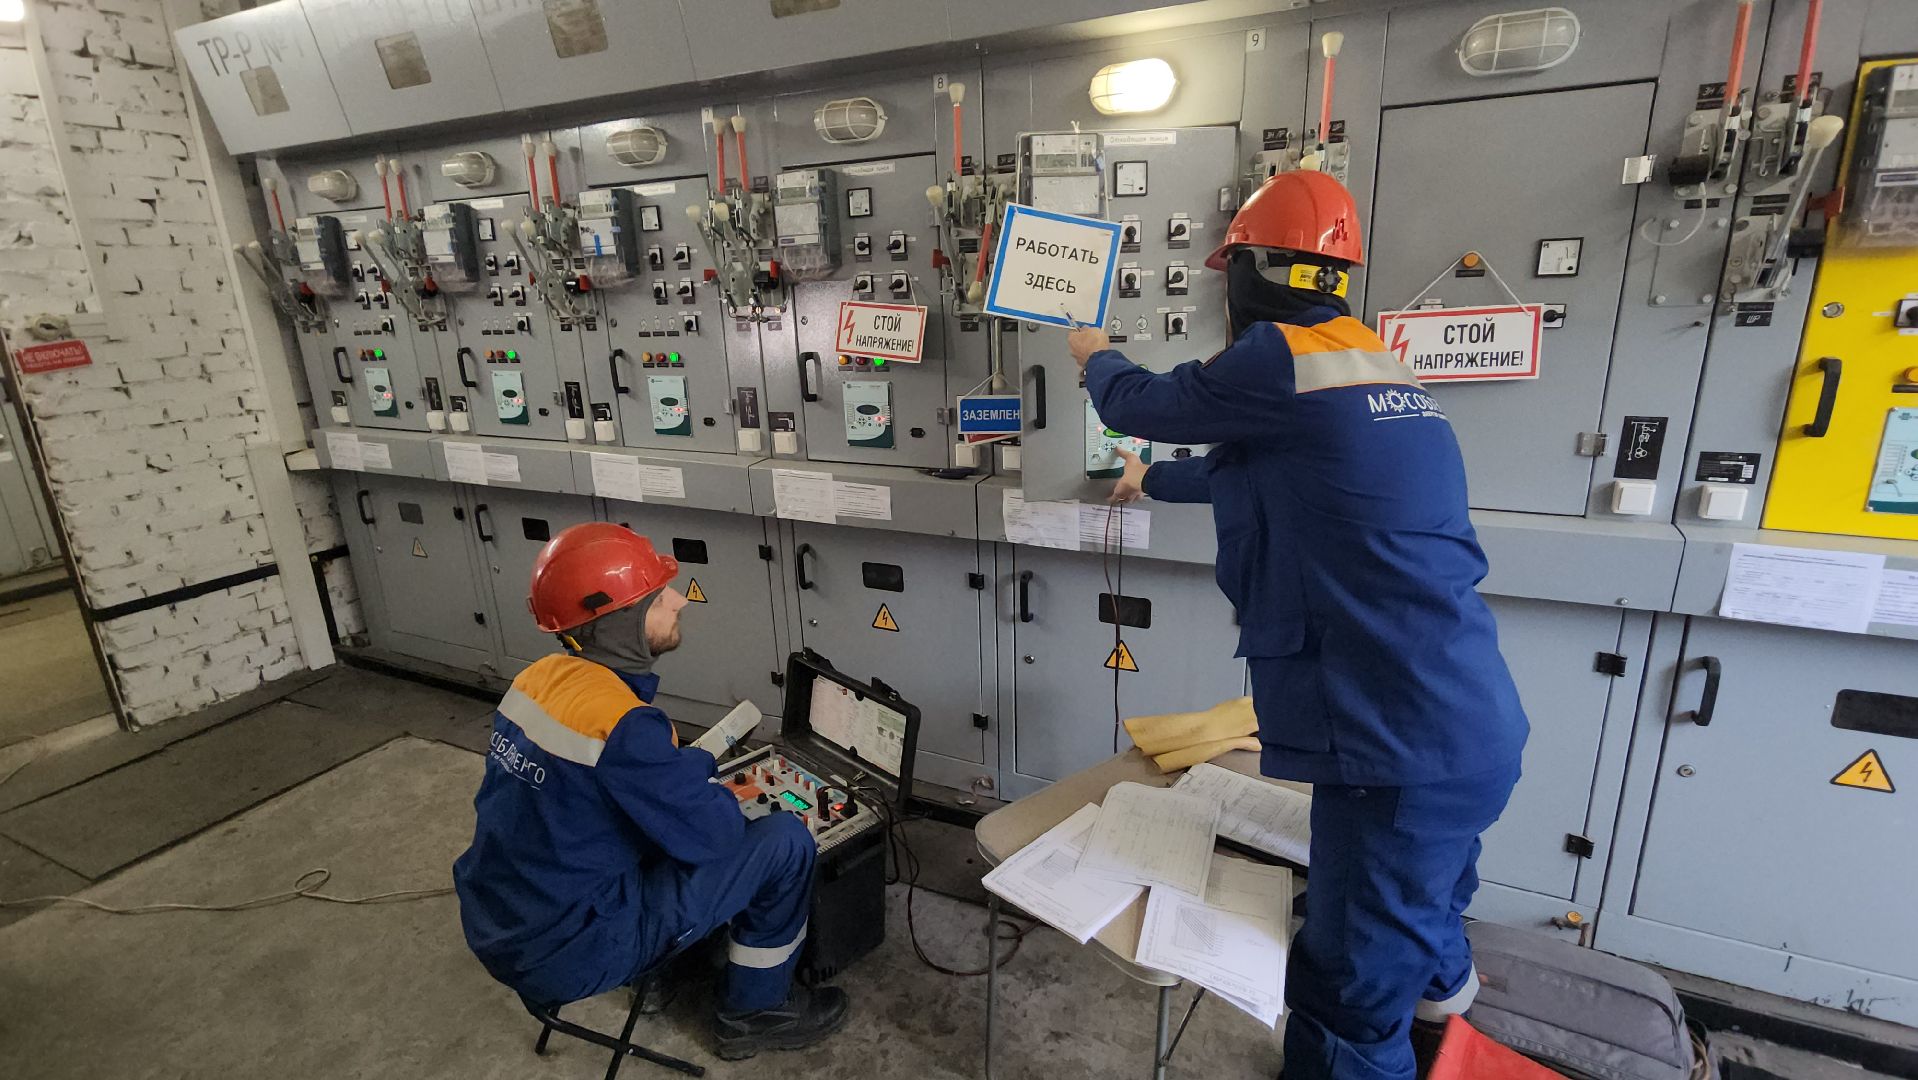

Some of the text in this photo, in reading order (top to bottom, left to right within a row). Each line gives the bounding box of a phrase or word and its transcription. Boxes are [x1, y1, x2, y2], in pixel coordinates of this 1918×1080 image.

[1252, 33, 1260, 46] 9
[938, 77, 944, 89] 8
[1015, 237, 1099, 265] РАБОТАТЬ
[1024, 272, 1076, 294] ЗДЕСЬ
[873, 312, 902, 332] СТОЙ
[1443, 316, 1496, 345] СТОЙ
[855, 335, 914, 353] НАПРЯЖЕНИЕ!
[1413, 350, 1524, 370] НАПРЯЖЕНИЕ!
